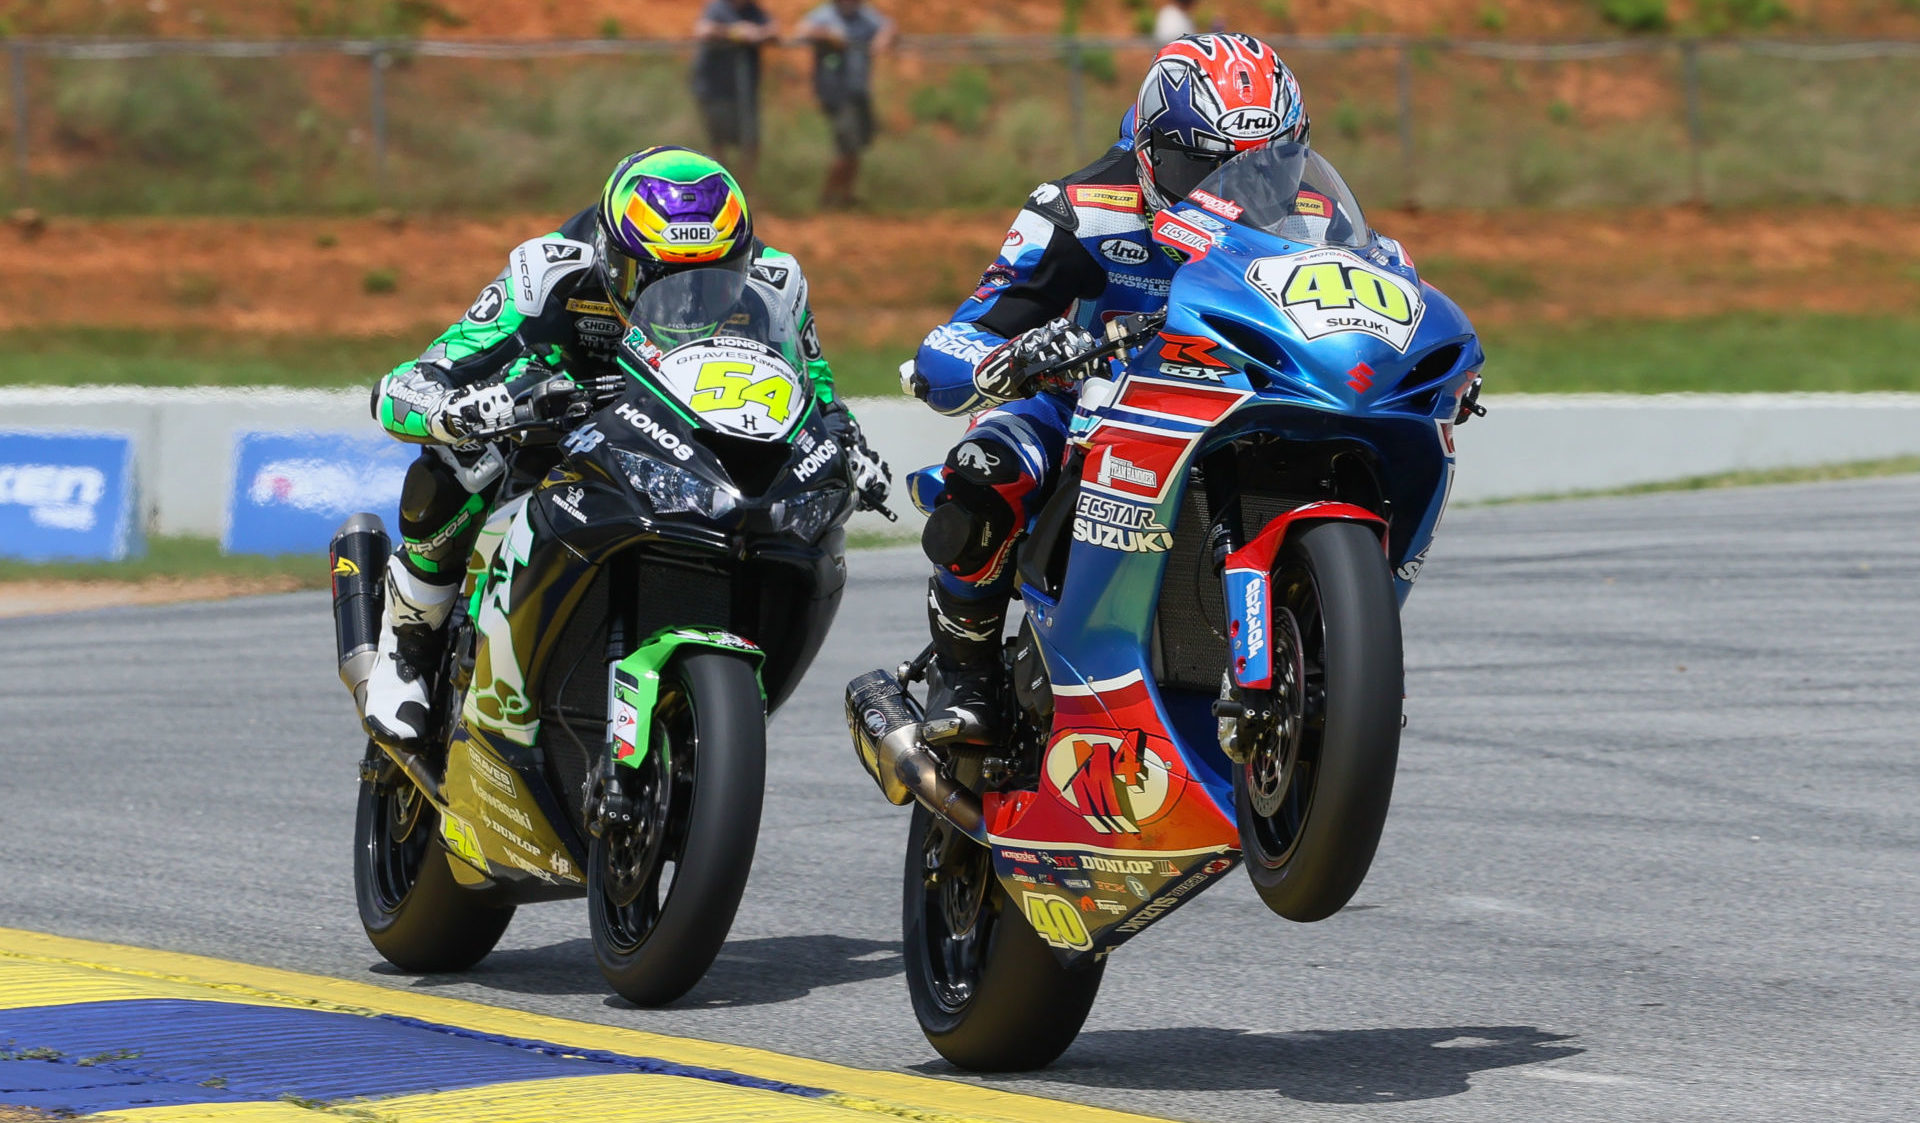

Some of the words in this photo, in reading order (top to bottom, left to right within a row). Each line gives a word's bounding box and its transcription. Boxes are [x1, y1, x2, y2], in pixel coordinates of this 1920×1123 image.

[1221, 112, 1274, 130] Arai
[1093, 192, 1133, 202] DUNLOP
[670, 227, 711, 241] SHOEI
[1102, 240, 1146, 260] Arai
[1160, 223, 1210, 252] ECSTAR
[1281, 262, 1413, 326] 40
[583, 321, 616, 331] SHOEI
[1326, 317, 1389, 335] SUZUKI
[677, 351, 748, 365] GRAVES
[713, 337, 768, 353] HONOS
[1158, 331, 1232, 369] R
[1160, 363, 1231, 382] GSX
[689, 361, 794, 426] 54
[615, 403, 694, 462] HONOS
[793, 439, 838, 482] HONOS
[1076, 493, 1166, 529] ECSTAR
[1073, 519, 1174, 552] SUZUKI
[1246, 578, 1265, 660] DUNLOP
[1063, 728, 1150, 834] M4
[470, 775, 533, 832] Kawasaki
[442, 810, 488, 872] 54
[492, 822, 541, 856] DUNLOP
[1079, 855, 1155, 875] DUNLOP
[1025, 893, 1090, 949] 40
[1115, 892, 1179, 932] SUZUKI
